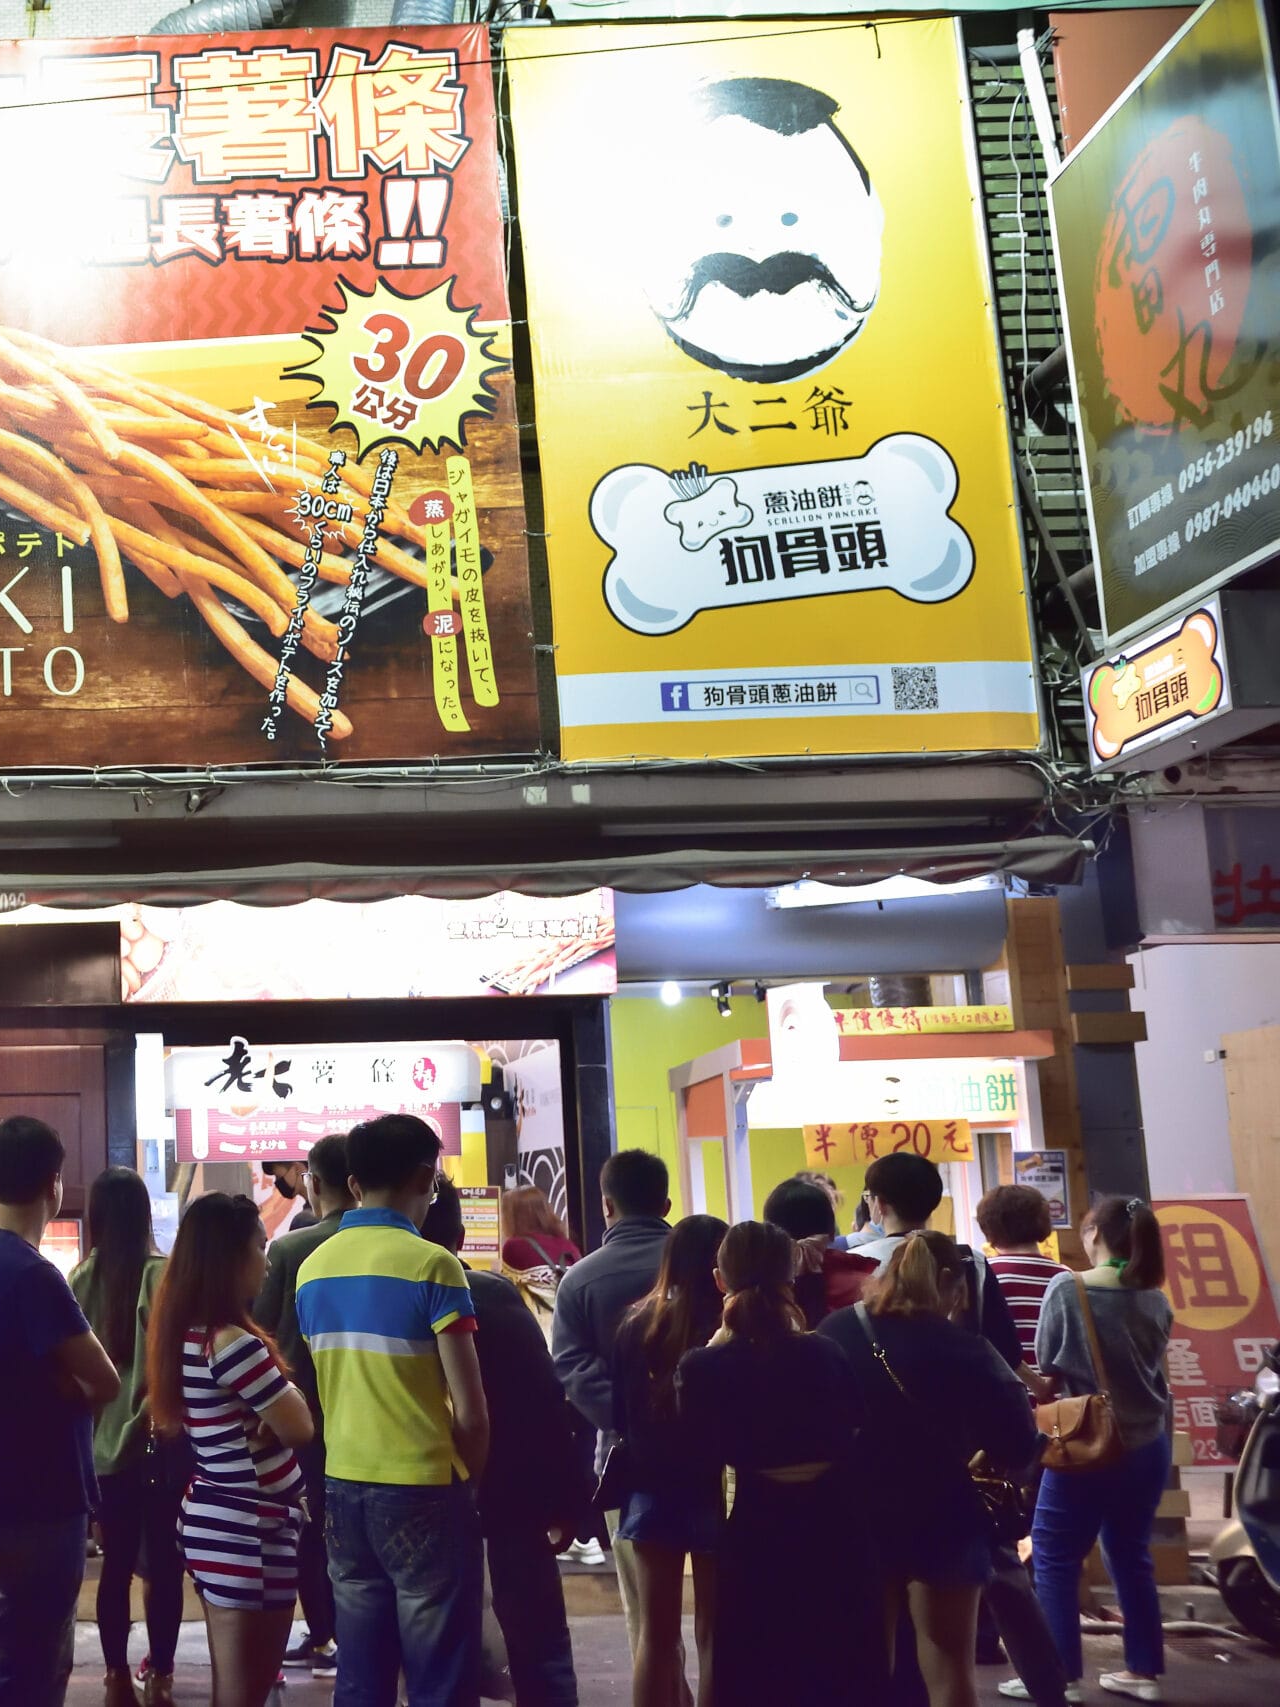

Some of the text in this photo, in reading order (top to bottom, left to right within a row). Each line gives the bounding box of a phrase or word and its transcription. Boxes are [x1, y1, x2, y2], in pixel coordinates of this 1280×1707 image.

[353, 313, 466, 400] 30
[352, 383, 419, 432] 公分
[686, 385, 854, 439] 大二爺
[1178, 410, 1274, 494] 0956-239196
[768, 507, 879, 527] SCALLION PANCAKE
[1184, 463, 1280, 543] 0987-040460
[448, 468, 493, 695] ジャガイモの皮を抜いて、
[719, 520, 889, 586] 狗骨頭
[1135, 671, 1190, 724] 狗骨頭
